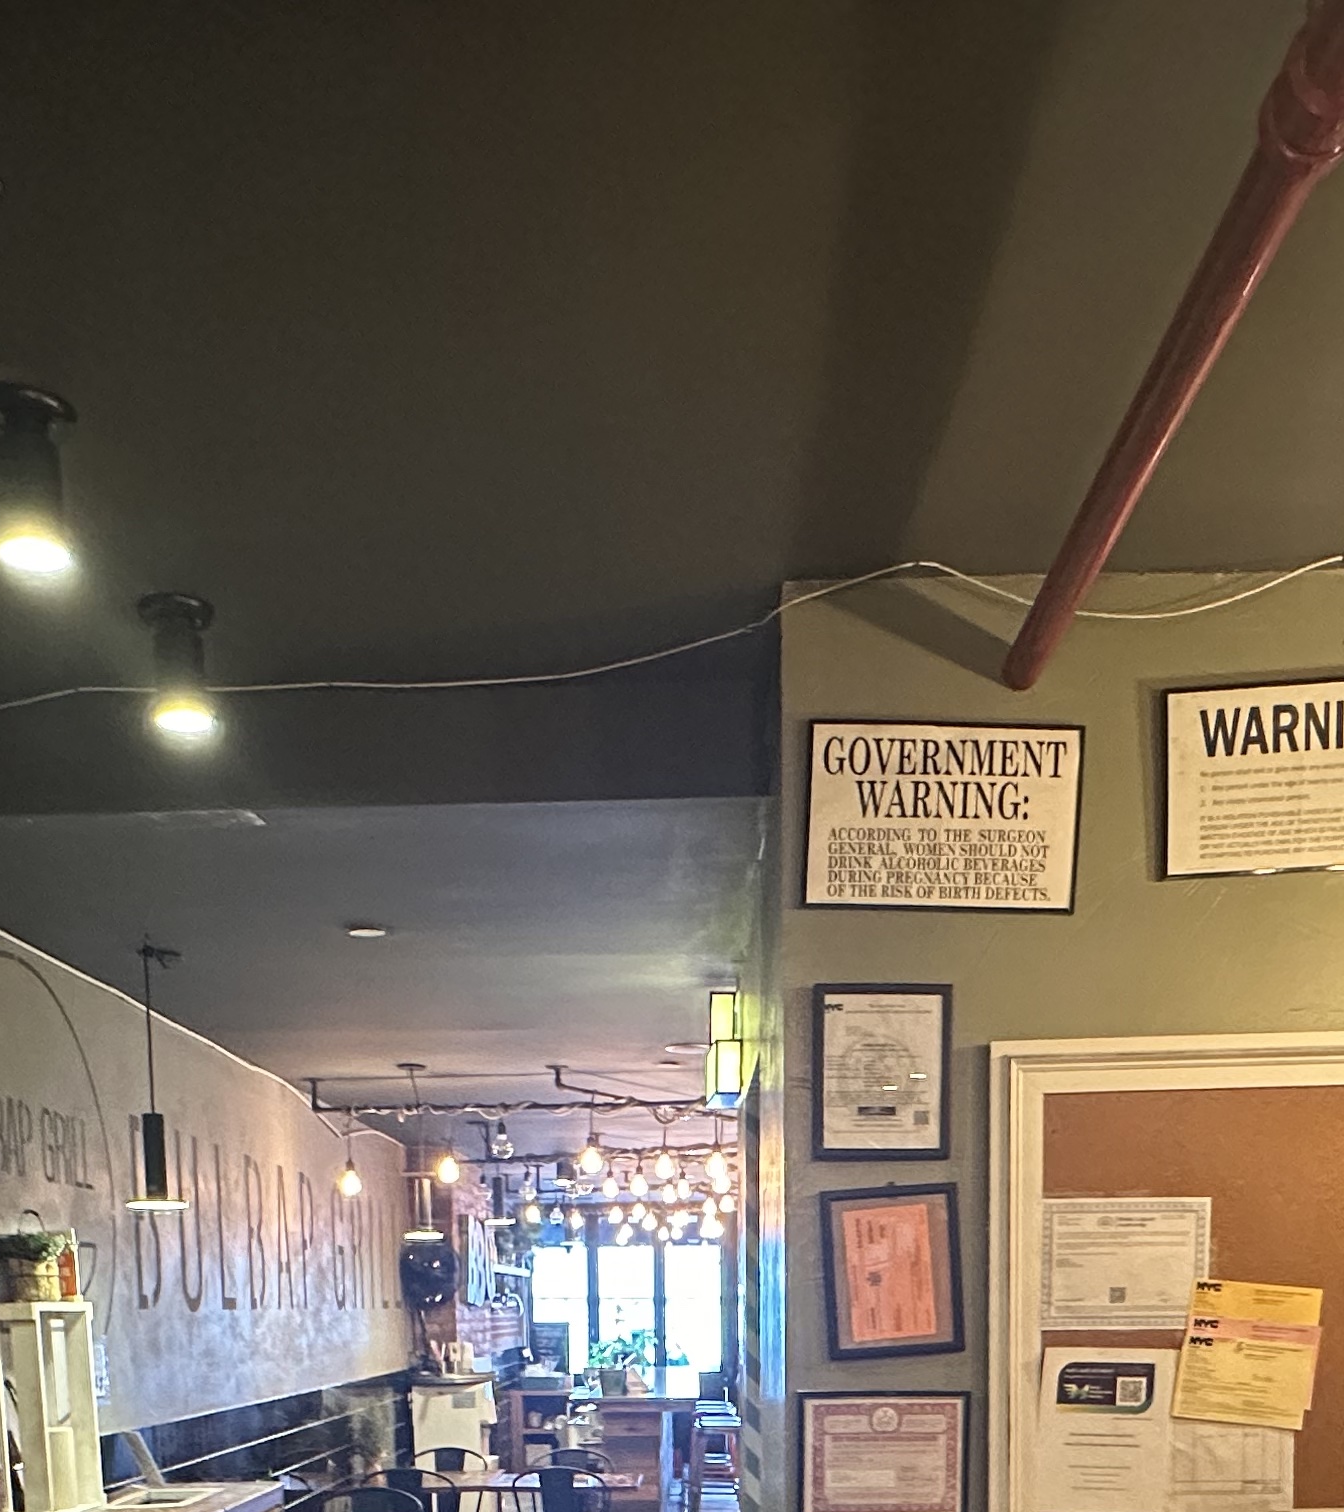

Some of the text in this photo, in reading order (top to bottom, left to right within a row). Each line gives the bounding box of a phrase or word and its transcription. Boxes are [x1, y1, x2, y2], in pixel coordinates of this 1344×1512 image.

[823, 736, 1067, 778] GOVERNMENT
[855, 780, 1029, 820] WARNING:
[828, 828, 1046, 843] ACCORDING TO THE SURGEON
[904, 843, 955, 856] WOMEN
[960, 844, 1016, 858] SHOULD
[1020, 845, 1050, 859] NOT
[828, 856, 1046, 872] DRINK ALCOHOLIC BEVERAGES
[828, 870, 1037, 886] DURING PREGNANCY BECAUSE
[826, 885, 1050, 901] OF THE RISK OF BIRTH DEFECTS.
[1196, 1281, 1223, 1293] NYC
[1193, 1318, 1219, 1329] NYC
[1188, 1336, 1214, 1347] NYC
